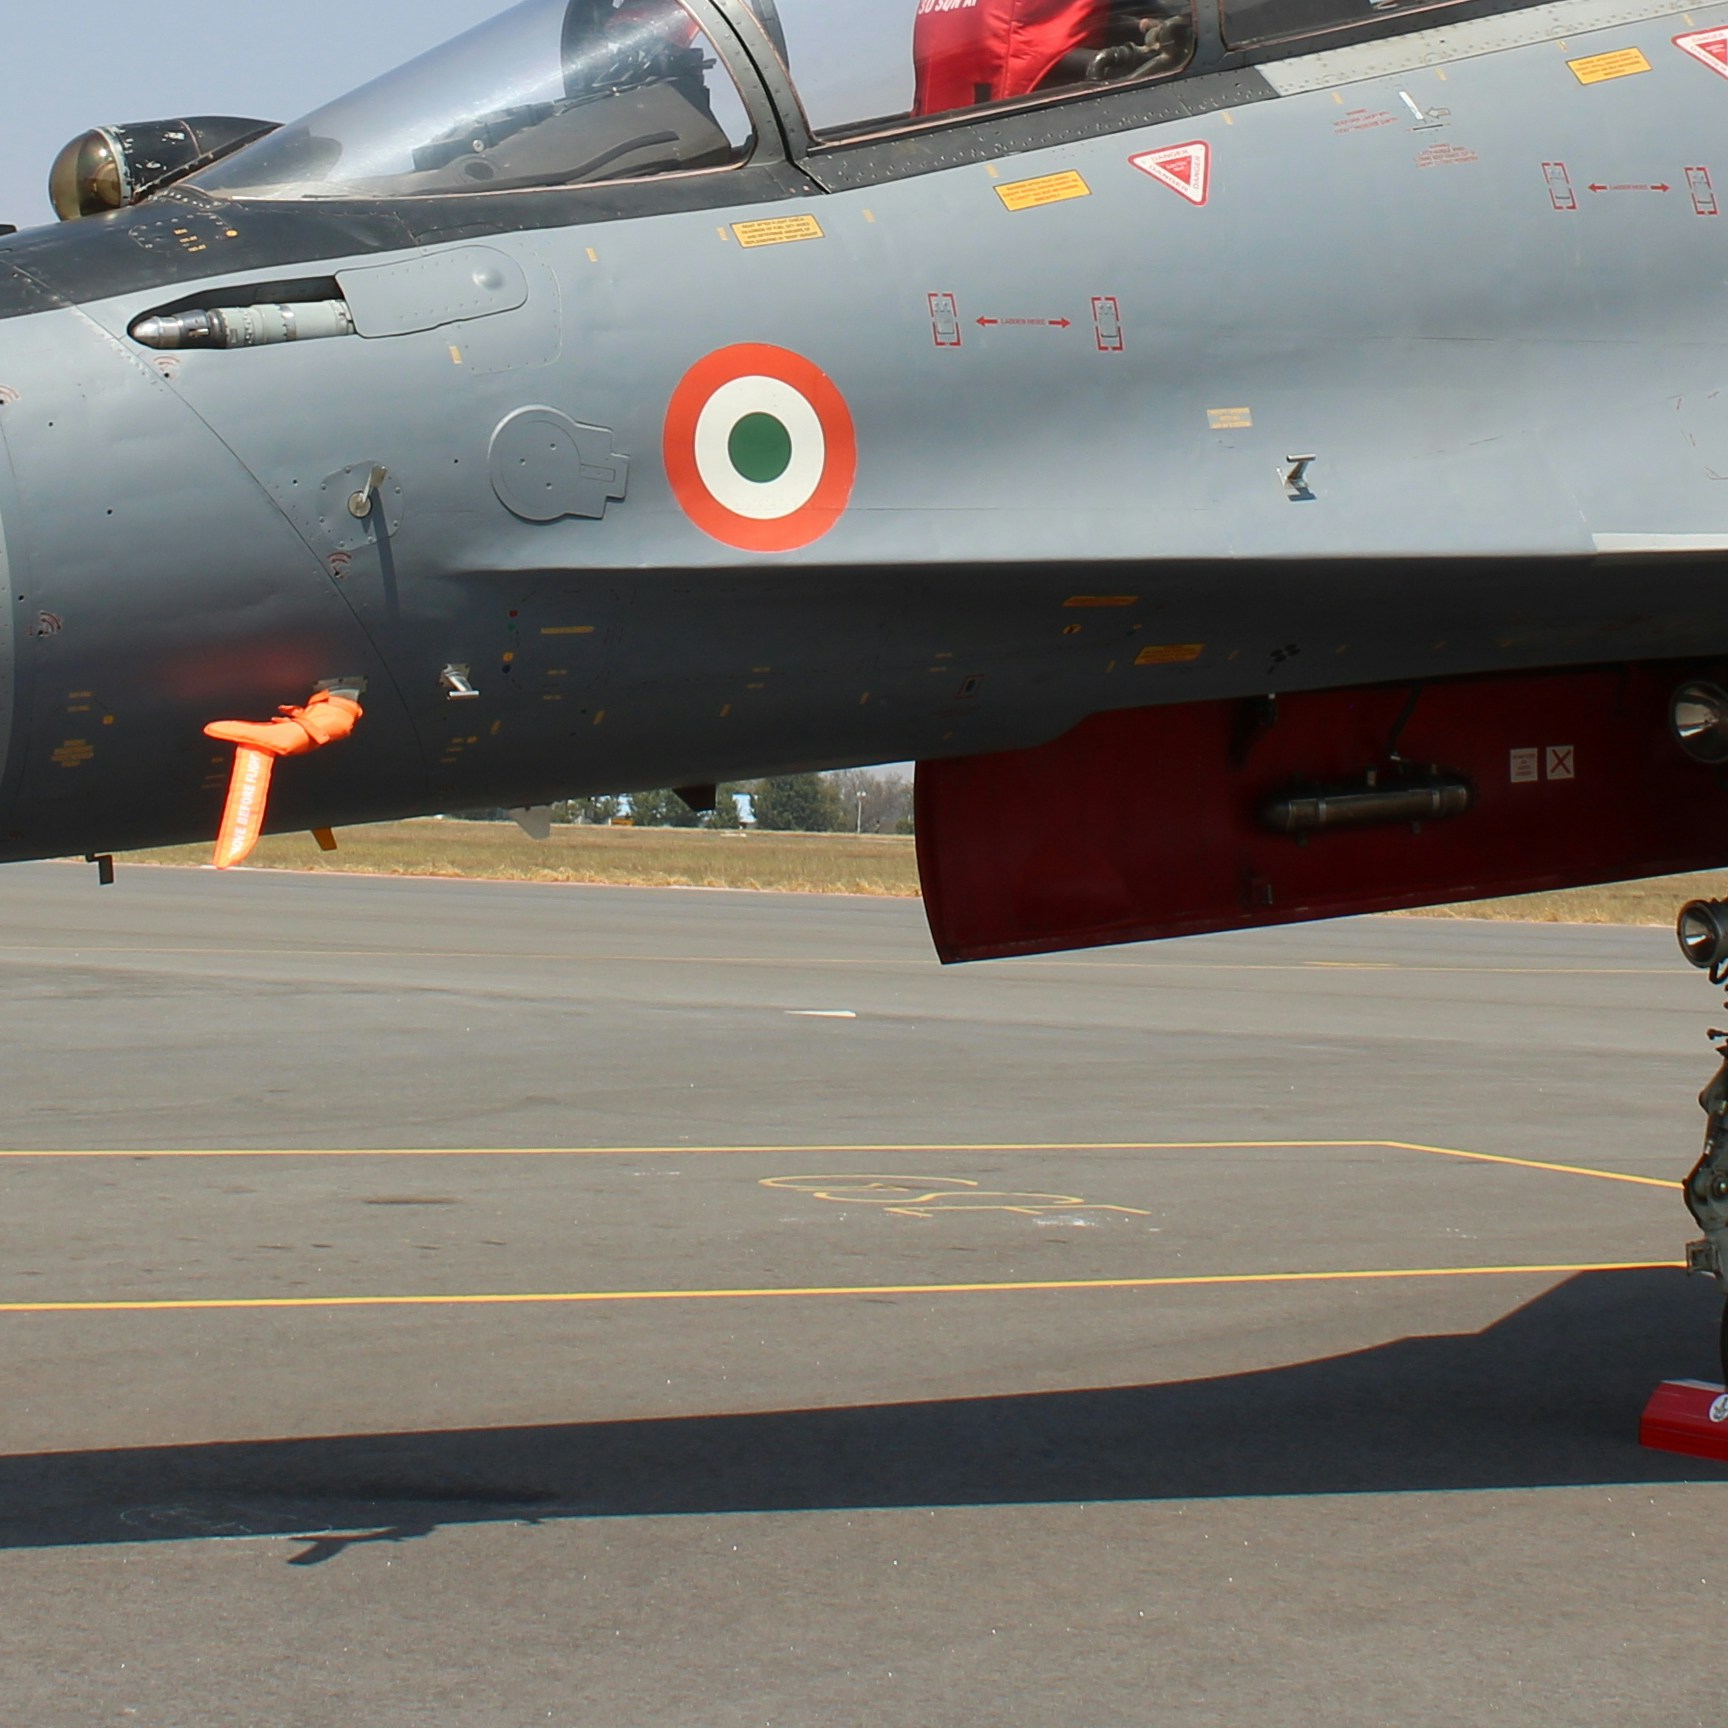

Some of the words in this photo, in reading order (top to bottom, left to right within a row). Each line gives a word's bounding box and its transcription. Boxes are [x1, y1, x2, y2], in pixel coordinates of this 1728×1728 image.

[1150, 149, 1189, 161] DANGER
[1149, 165, 1189, 192] DANGER
[1192, 155, 1201, 189] DANGER
[236, 783, 256, 826] BEFORE
